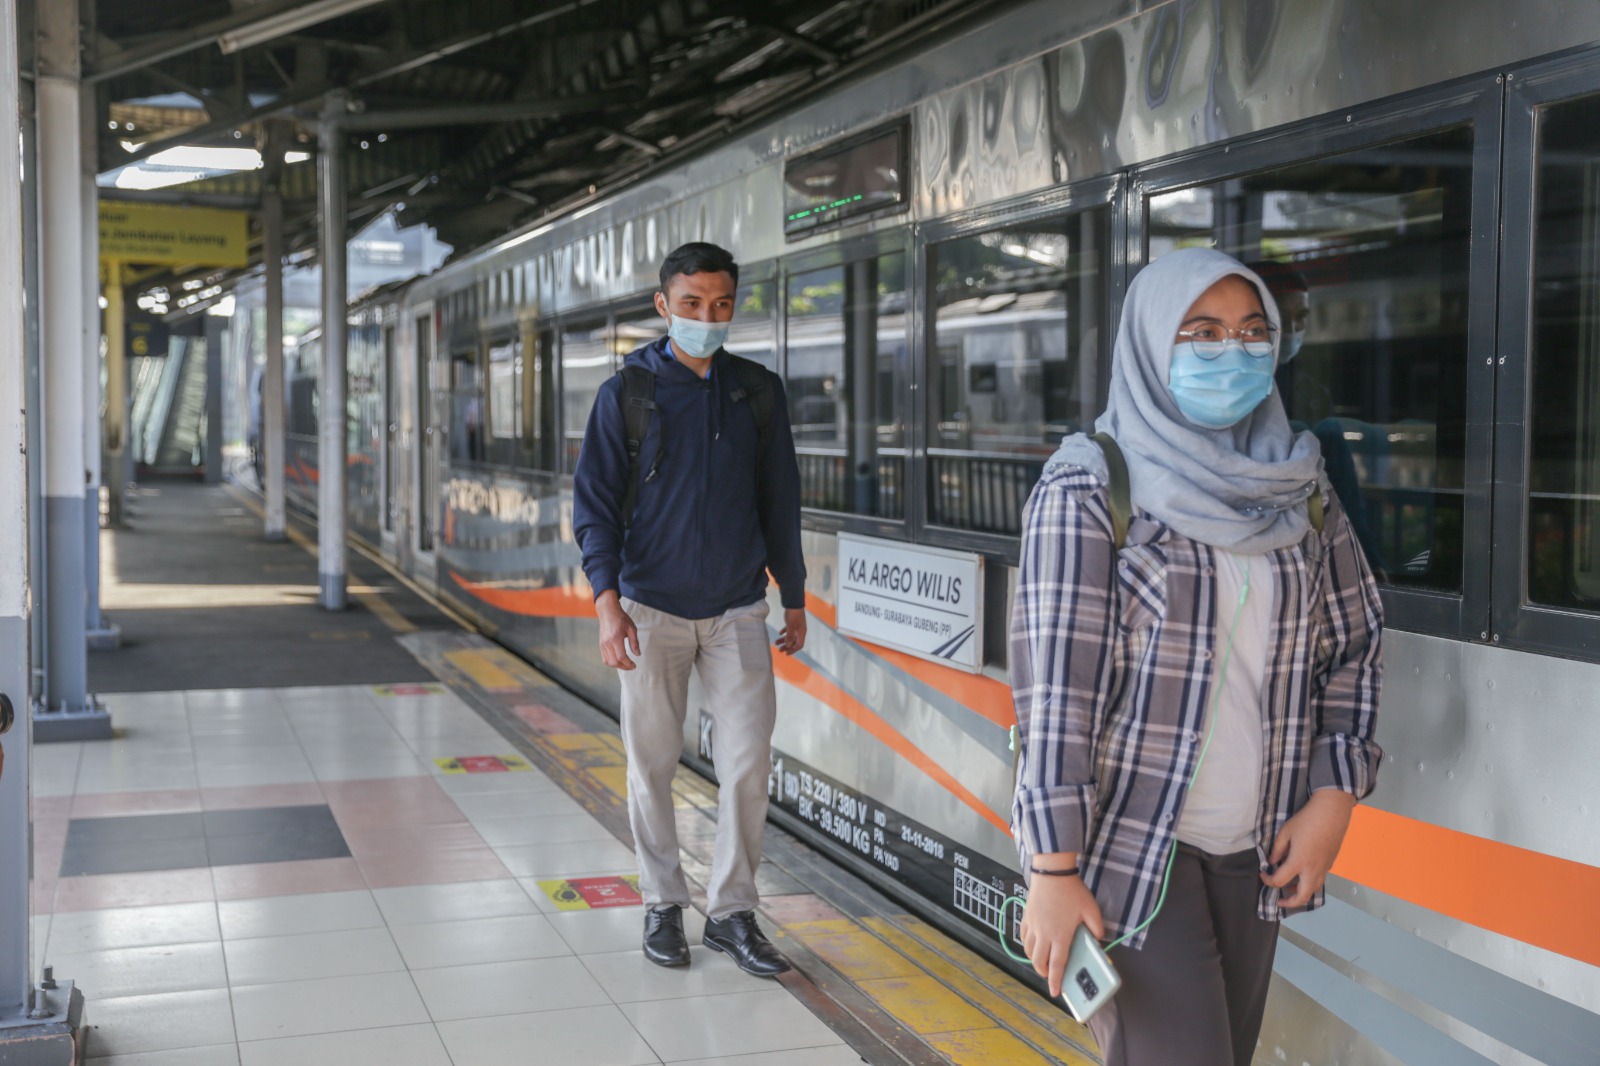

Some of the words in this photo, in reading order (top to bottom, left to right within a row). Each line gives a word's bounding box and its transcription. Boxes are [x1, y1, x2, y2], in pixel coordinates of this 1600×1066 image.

[848, 557, 867, 585] KA
[869, 562, 913, 594] ARGO
[917, 569, 962, 605] WILIS
[854, 601, 881, 619] BANDUNG
[884, 608, 912, 626] SURABAYA
[913, 616, 939, 635] GUBENG
[939, 622, 952, 639] (PP)
[799, 769, 813, 796] TS
[813, 778, 832, 806] 220
[837, 791, 857, 821] 380
[858, 801, 868, 825] V
[798, 795, 814, 822] BK
[820, 806, 852, 845] 39.500
[853, 825, 871, 855] KG
[873, 827, 885, 846] PA
[902, 825, 945, 859] 21-11-2018
[873, 845, 885, 864] PA
[954, 852, 970, 870] PEM
